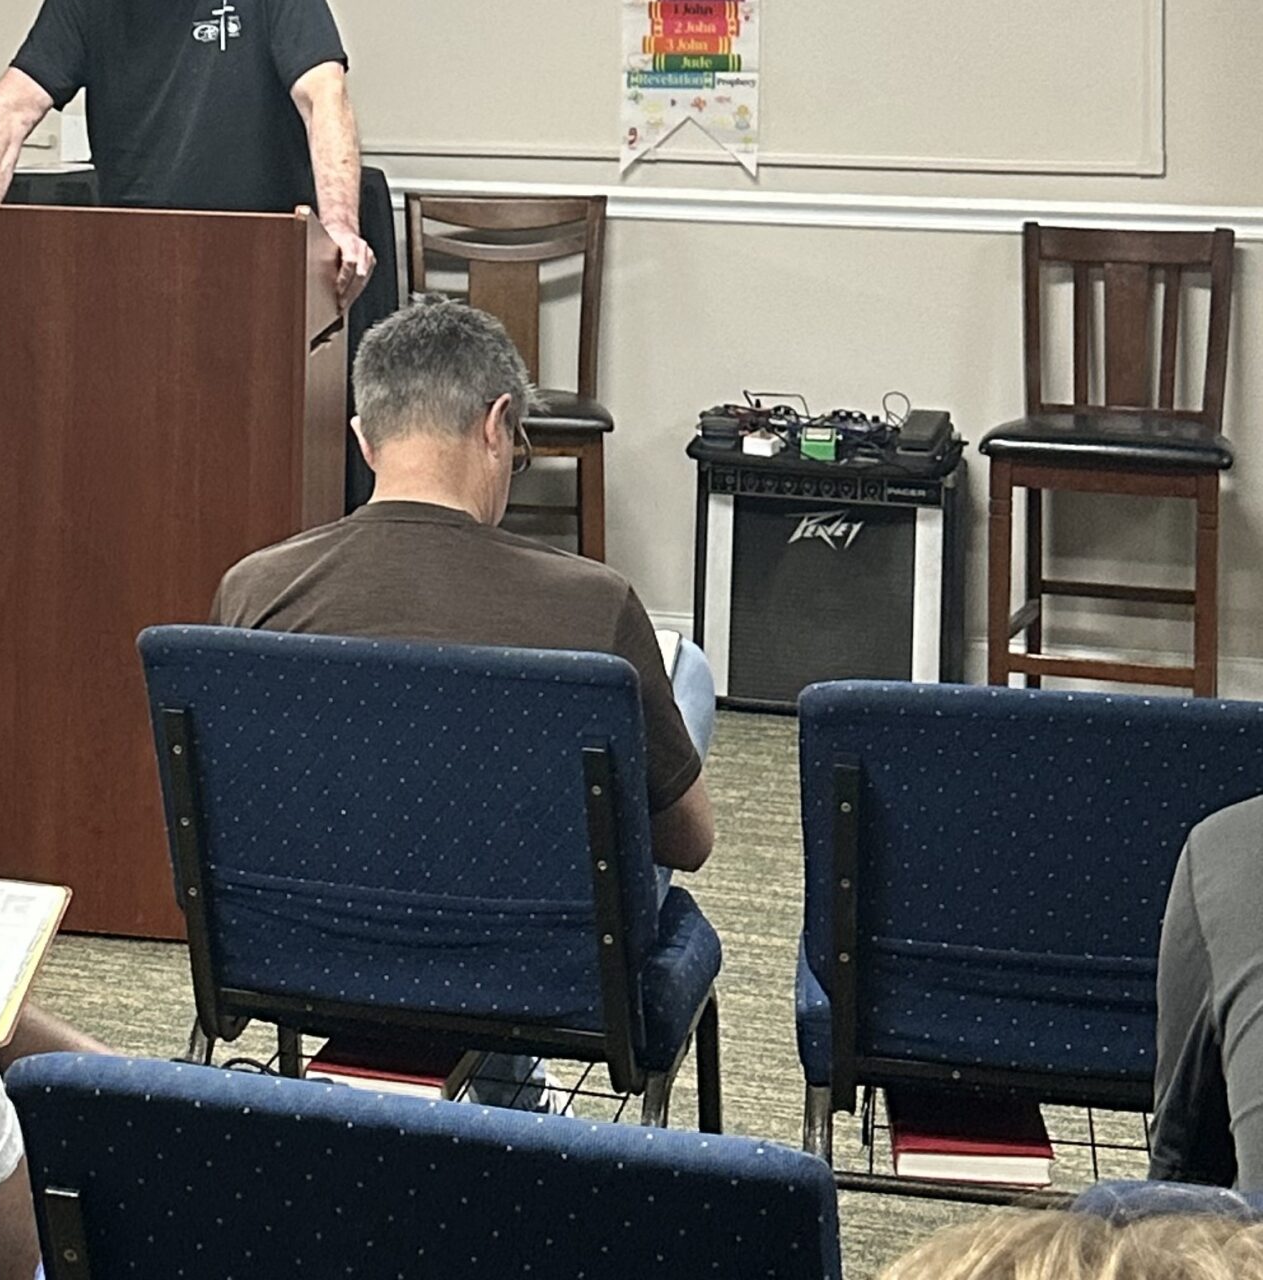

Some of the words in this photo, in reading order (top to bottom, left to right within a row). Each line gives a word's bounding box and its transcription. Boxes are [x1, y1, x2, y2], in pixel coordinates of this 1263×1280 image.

[683, 2, 715, 16] John
[673, 21, 683, 34] 2
[684, 20, 717, 35] John
[674, 38, 710, 52] John
[680, 55, 714, 70] Jude
